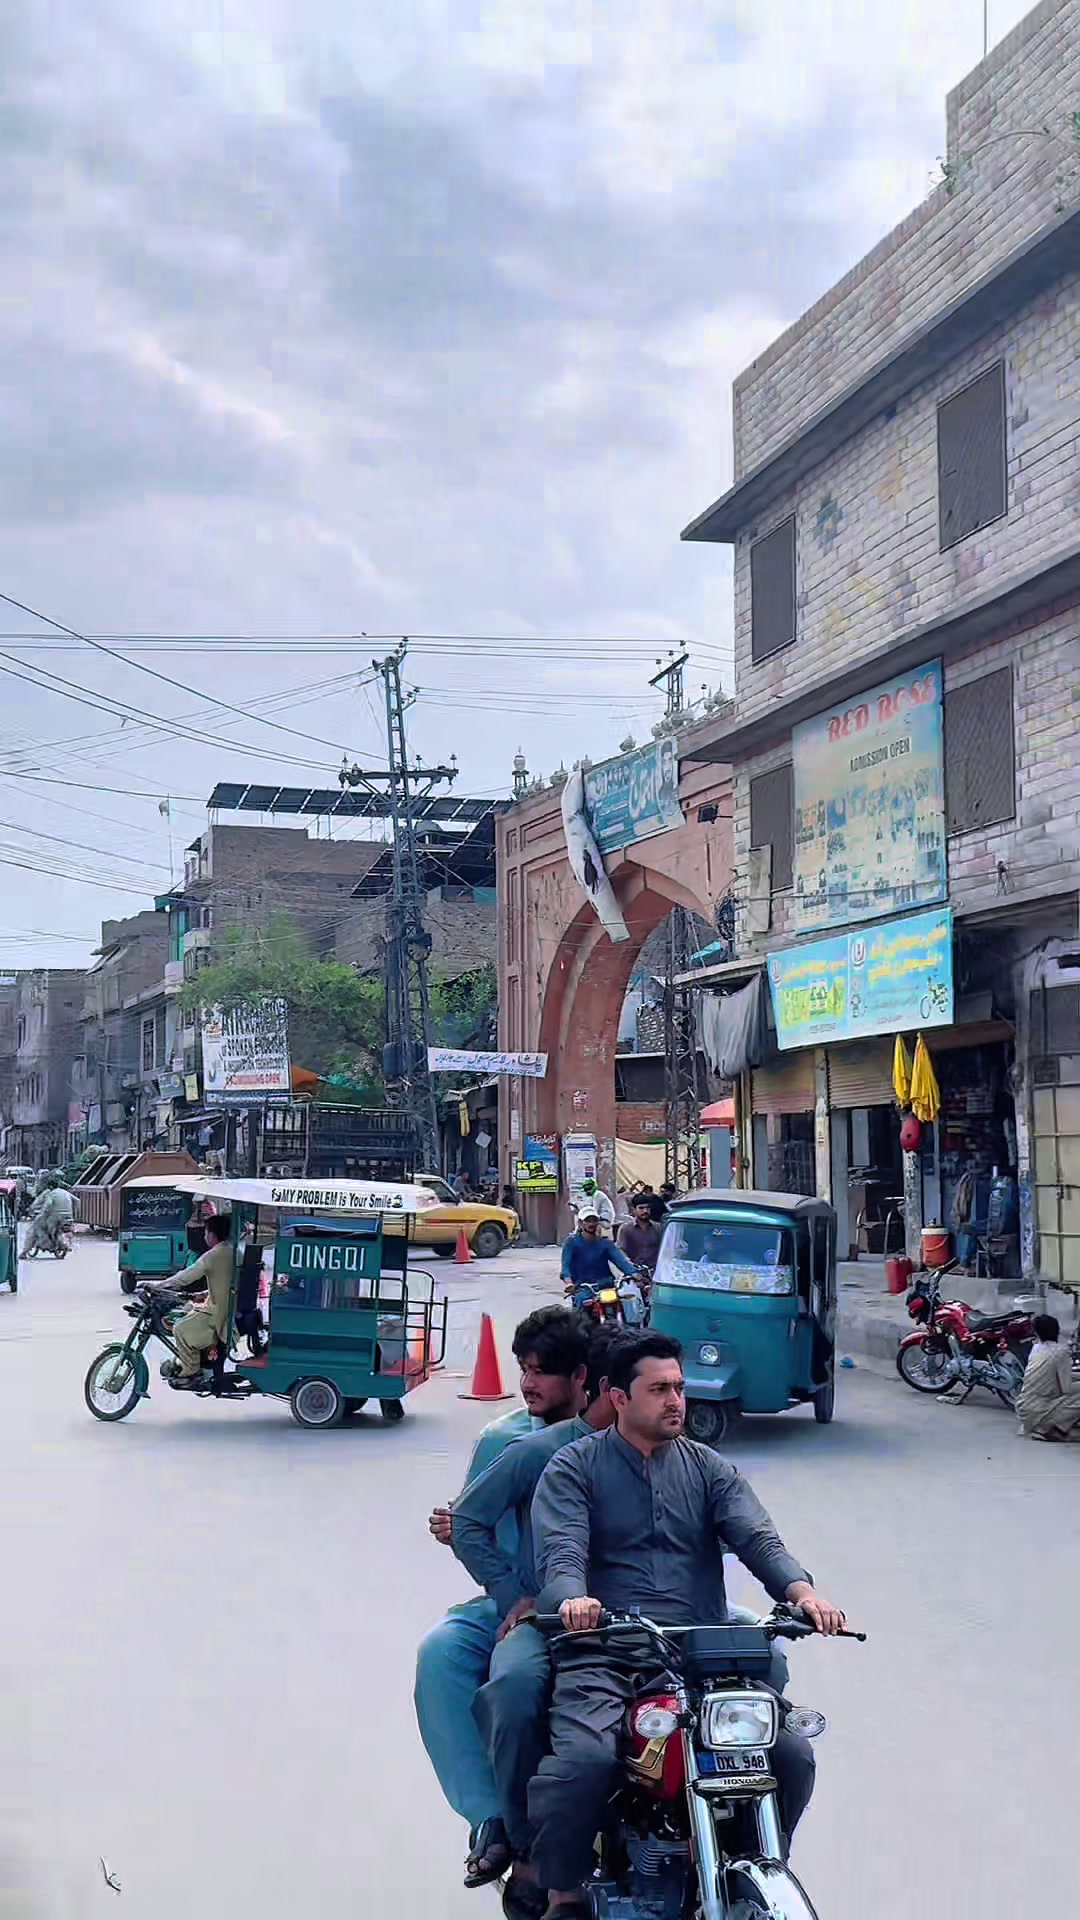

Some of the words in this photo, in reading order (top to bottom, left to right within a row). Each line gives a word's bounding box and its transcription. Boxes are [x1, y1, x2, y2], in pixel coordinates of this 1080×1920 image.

[827, 704, 871, 743] RED
[890, 737, 911, 759] OPEN
[282, 1188, 295, 1201] MY
[297, 1189, 338, 1206] PROBLEM
[349, 1192, 367, 1208] Your
[369, 1193, 392, 1209] Smile
[290, 1243, 365, 1271] QINGQI
[742, 1755, 765, 1770] 948
